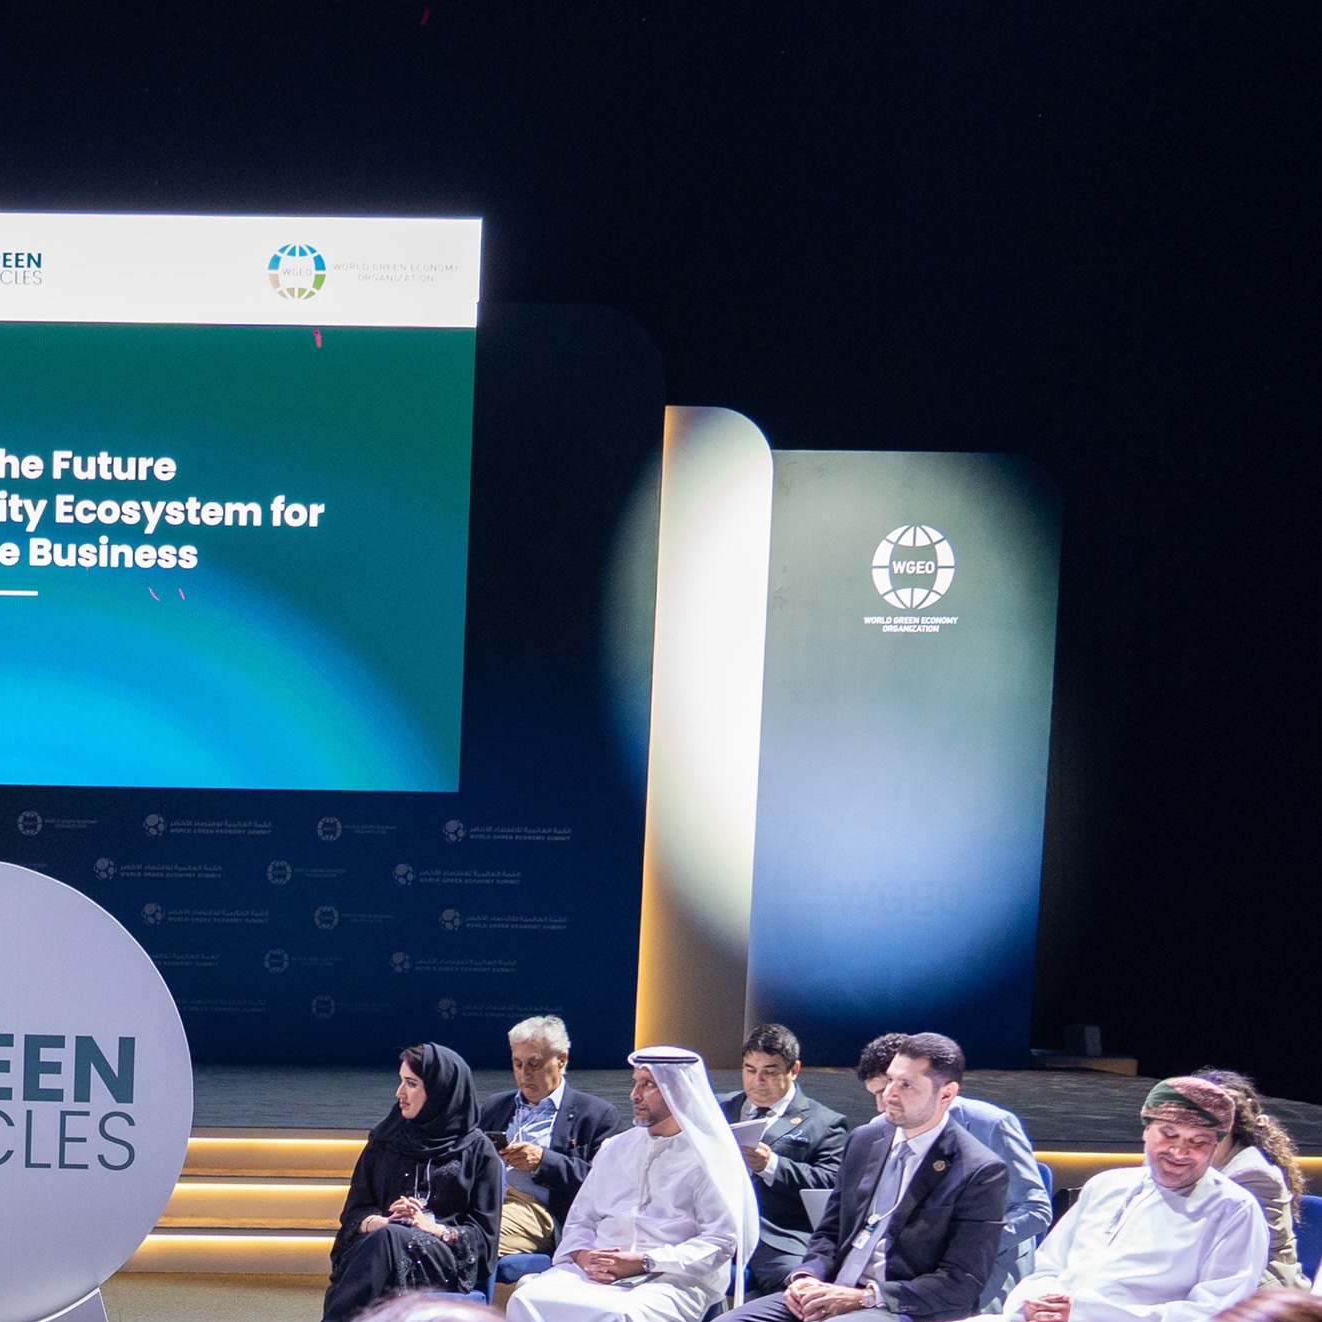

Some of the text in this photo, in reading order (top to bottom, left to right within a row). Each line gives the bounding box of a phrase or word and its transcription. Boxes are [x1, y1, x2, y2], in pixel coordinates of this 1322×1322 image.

[282, 267, 313, 277] WGEO
[333, 262, 370, 271] WORLD
[410, 263, 460, 272] ECONOMY
[53, 451, 176, 480] Future
[56, 495, 261, 534] Ecosystem
[271, 495, 325, 527] for
[29, 537, 197, 568] Business
[893, 561, 934, 574] WGEO
